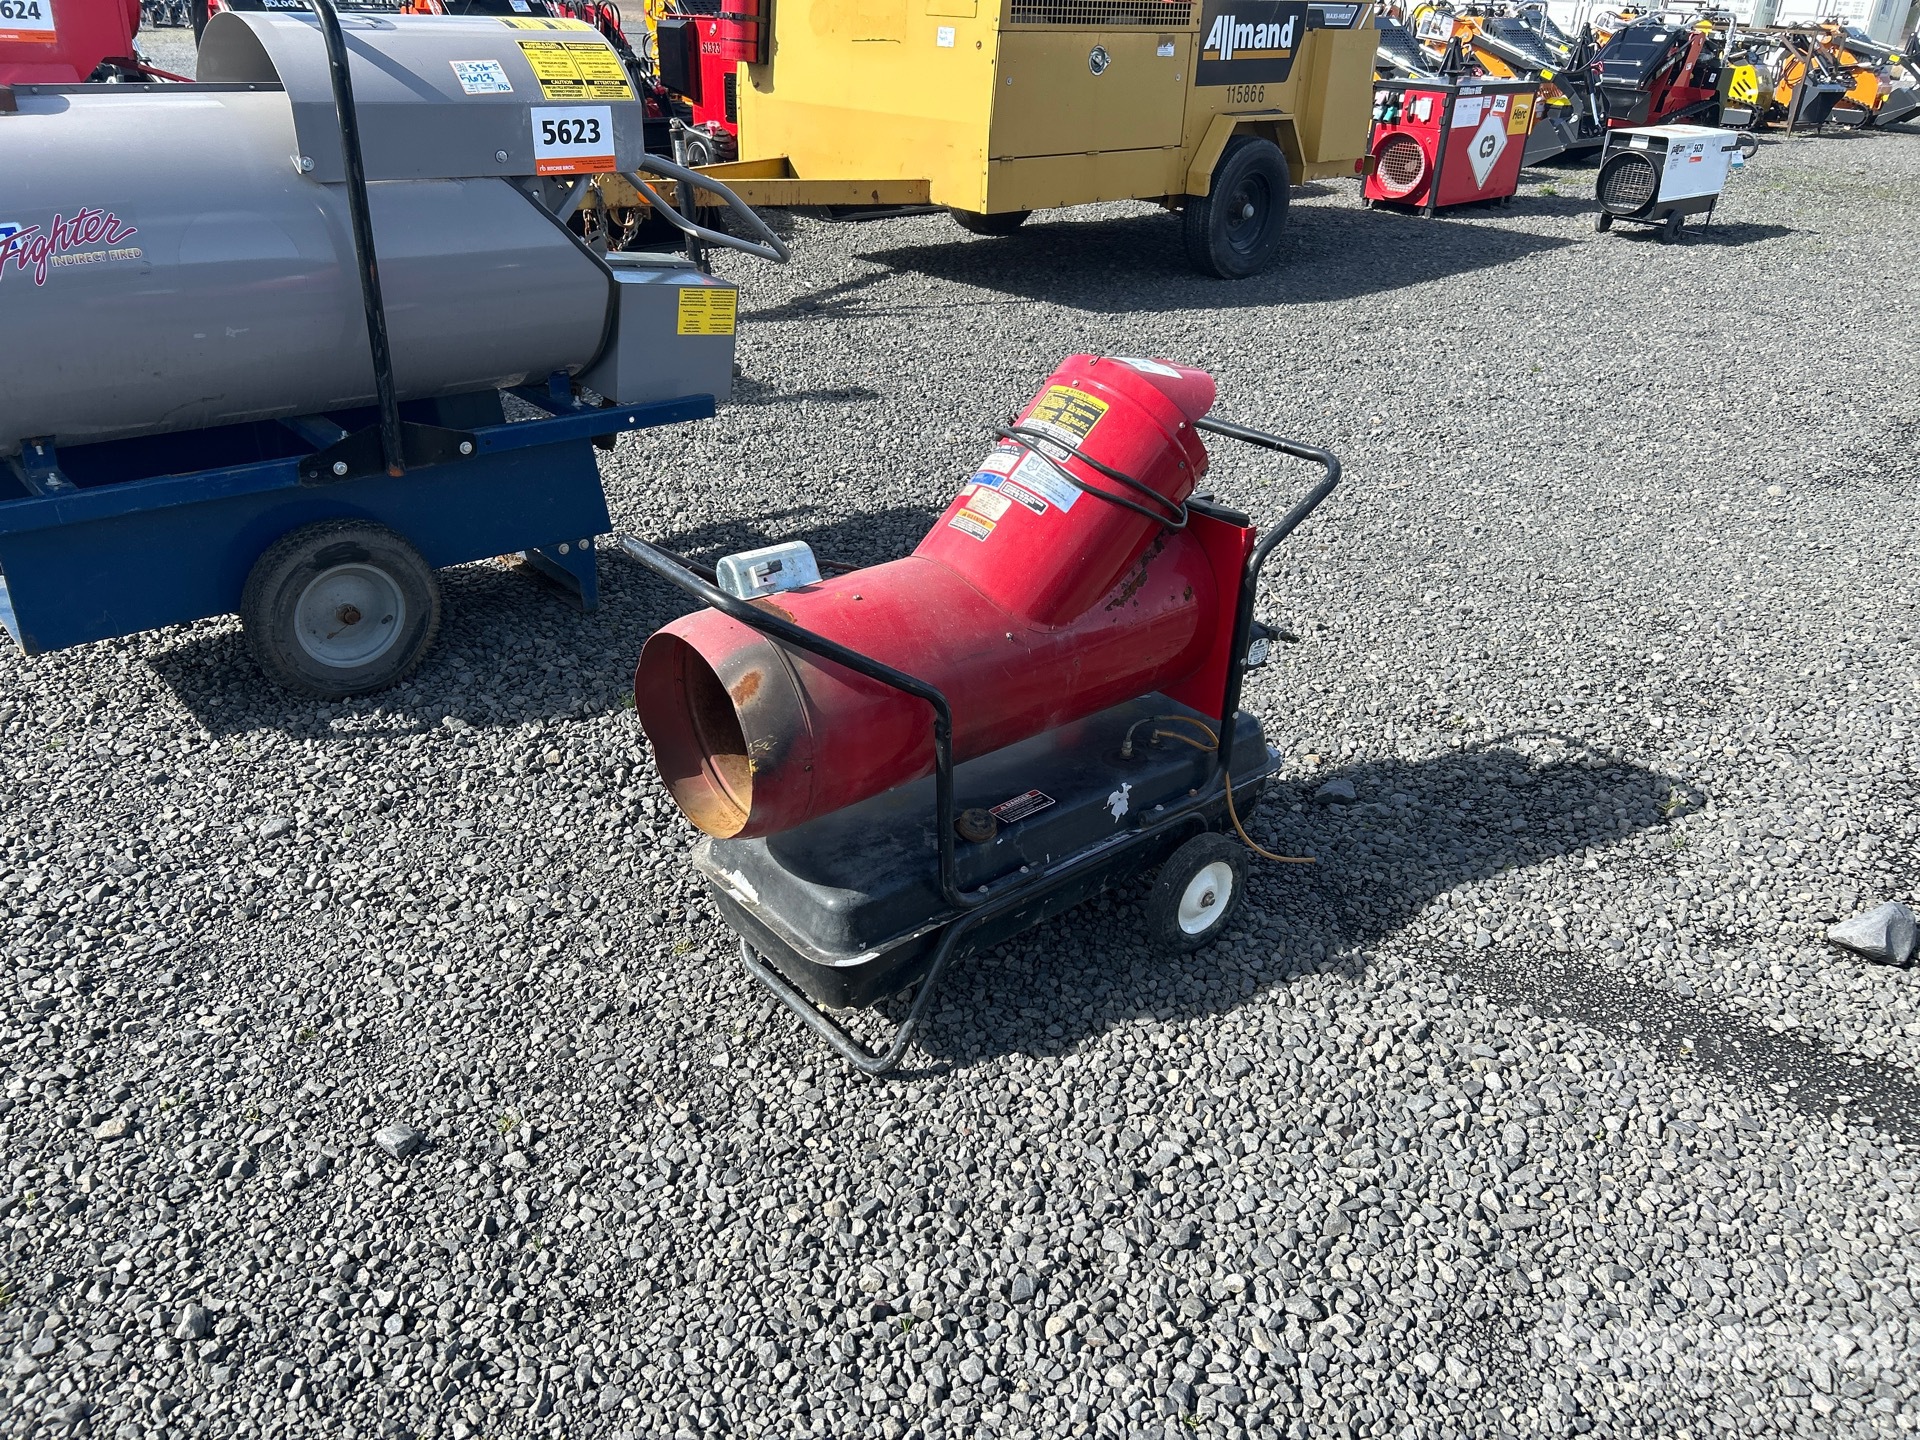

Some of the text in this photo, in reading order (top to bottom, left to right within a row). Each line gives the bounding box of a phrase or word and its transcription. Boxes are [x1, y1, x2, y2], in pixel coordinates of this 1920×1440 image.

[1203, 15, 1295, 61] Allmand
[1227, 85, 1265, 104] 115866
[1512, 109, 1527, 120] Herc
[541, 119, 601, 145] 5623
[0, 207, 137, 287] Fighter
[50, 247, 143, 268] INDIRECT FIRED
[1005, 794, 1032, 807] DANGER
